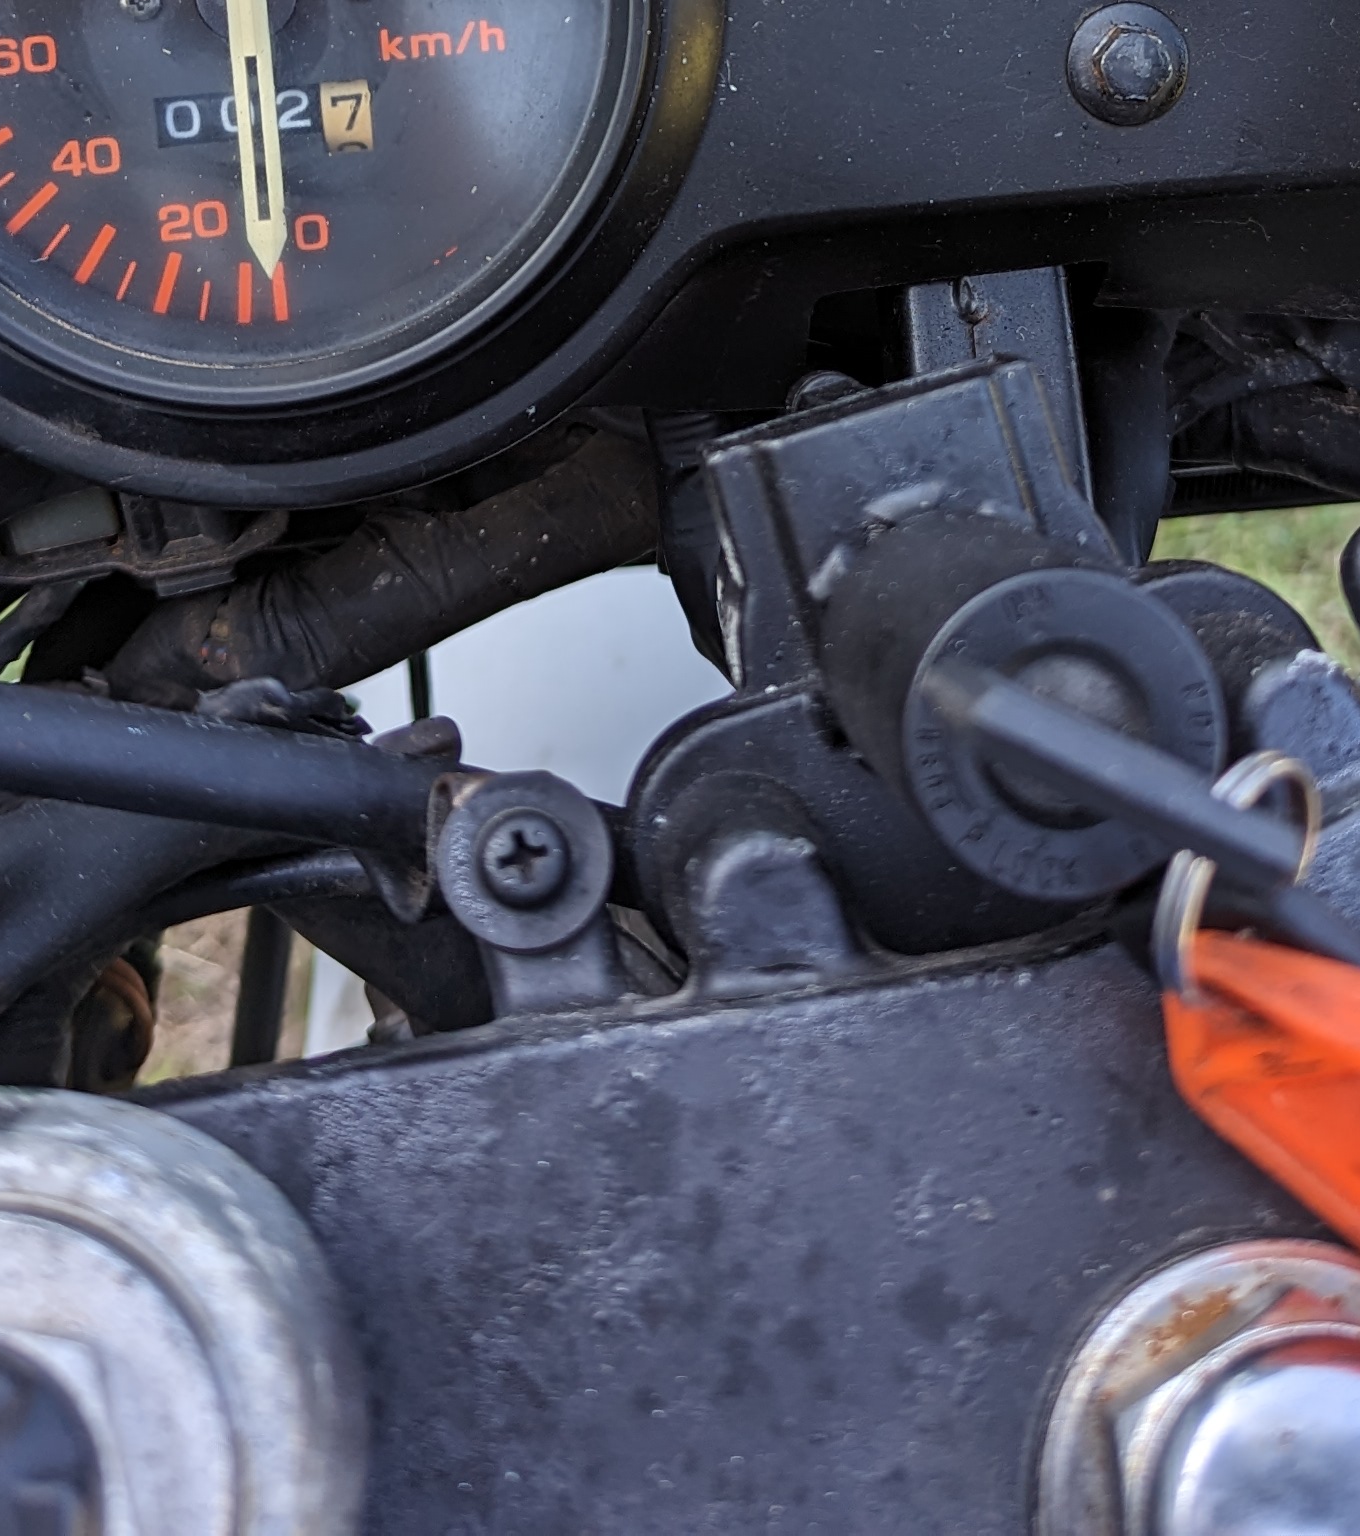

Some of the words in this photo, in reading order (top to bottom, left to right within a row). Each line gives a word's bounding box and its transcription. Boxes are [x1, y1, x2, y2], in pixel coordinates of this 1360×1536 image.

[379, 21, 504, 61] km/h
[53, 138, 119, 175] 40
[160, 202, 227, 240] 20
[296, 215, 328, 249] 0
